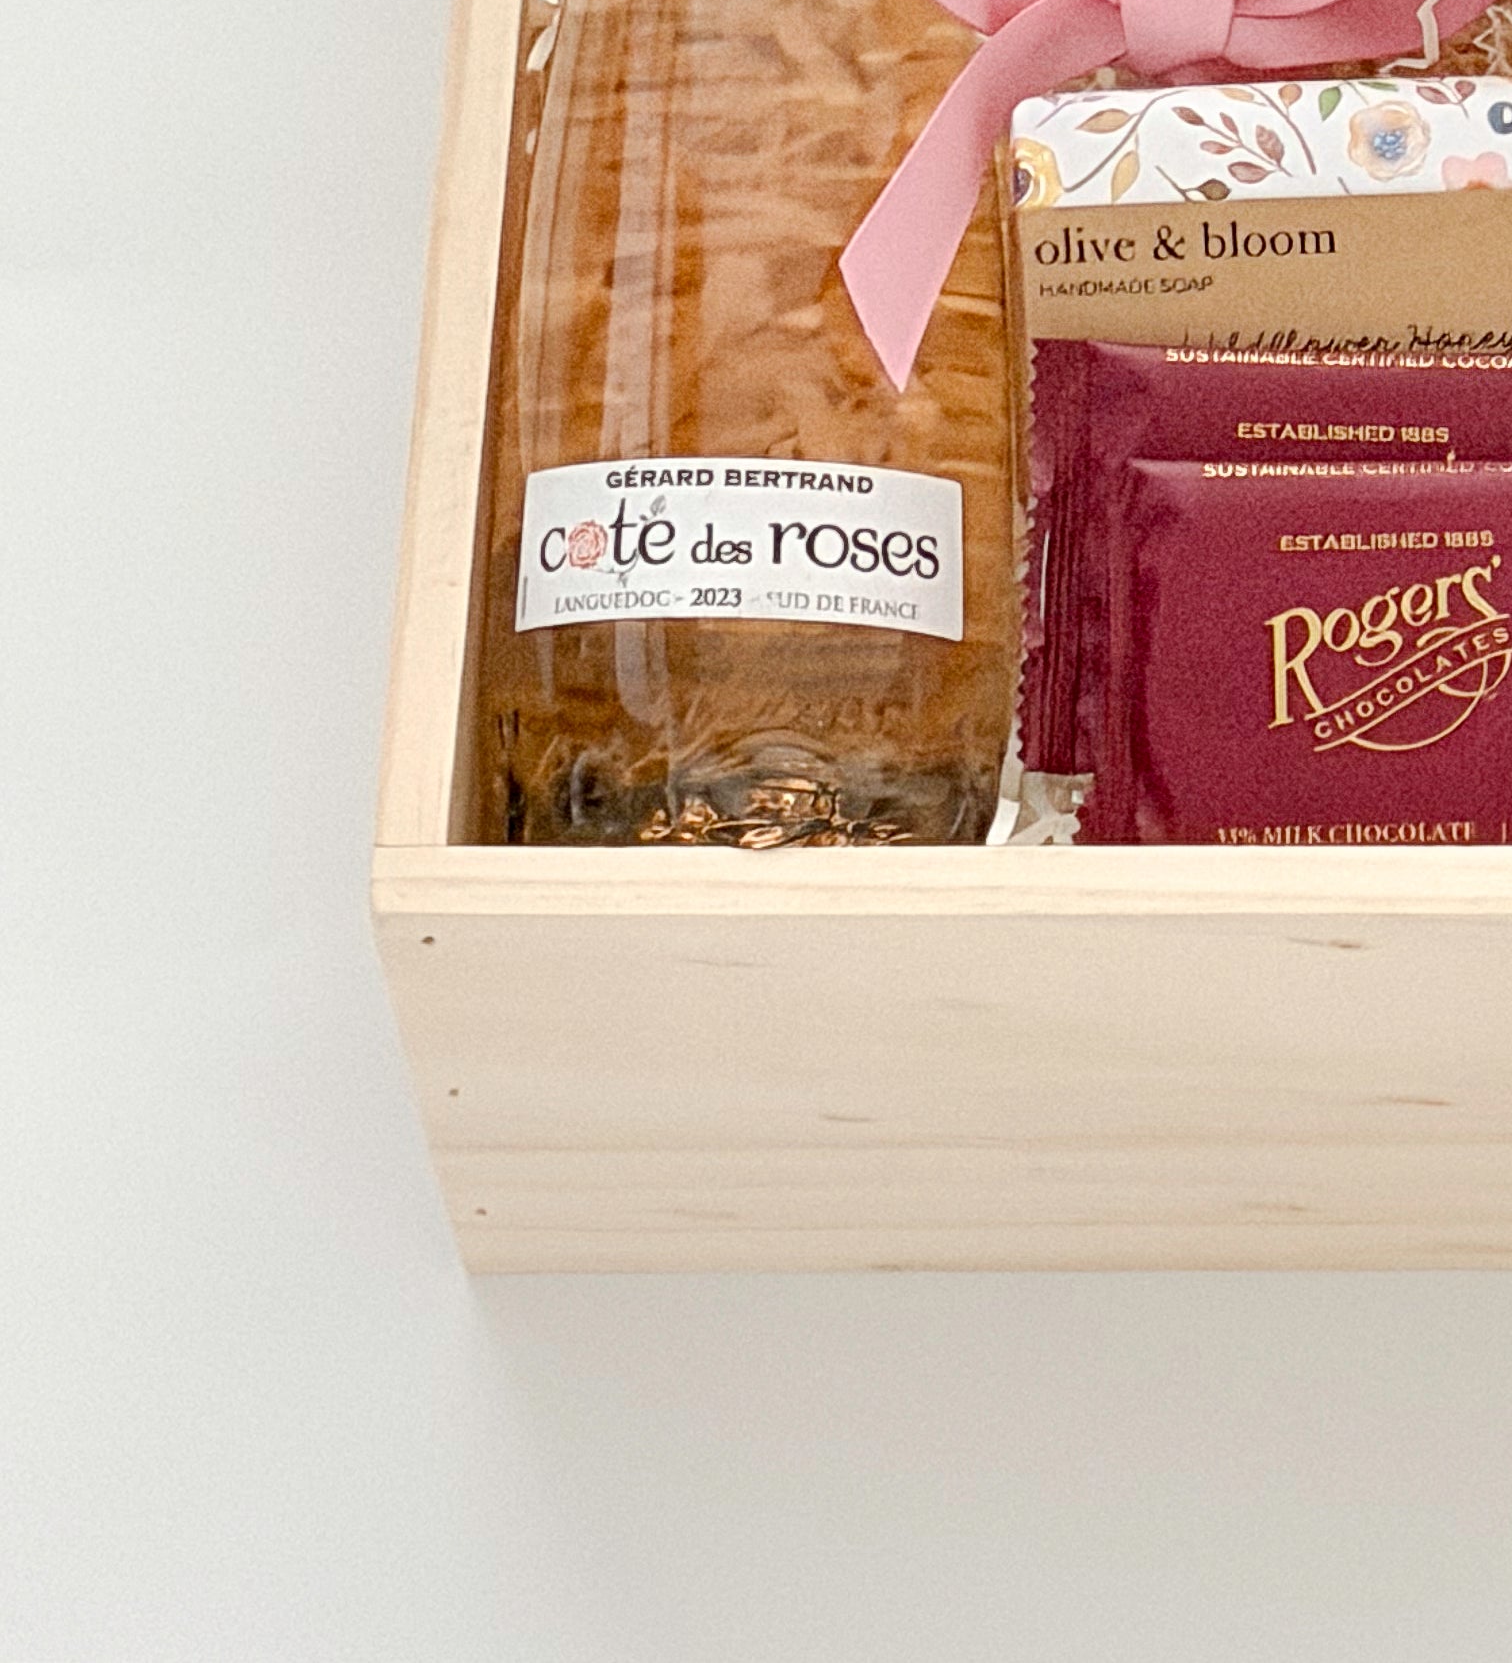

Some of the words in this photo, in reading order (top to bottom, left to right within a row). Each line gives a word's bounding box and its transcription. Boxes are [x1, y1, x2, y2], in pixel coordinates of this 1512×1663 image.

[1034, 226, 1136, 265] olive
[1152, 224, 1186, 261] &
[1202, 220, 1337, 259] bloom
[1039, 279, 1154, 297] HANDMADE
[1159, 275, 1214, 294] SOAP
[1237, 422, 1395, 443] ESTABLISHED
[606, 466, 714, 489] GÉRARD
[724, 469, 874, 494] BERTRAND
[690, 523, 753, 565] des
[768, 521, 940, 580] roses
[1280, 533, 1438, 552] ESTABLISHED
[554, 589, 671, 615] LANGUEDOC
[690, 587, 742, 608] 2023
[816, 594, 845, 612] DE
[849, 596, 921, 621] FRANCE
[1264, 554, 1512, 729] Rogers'
[1314, 627, 1510, 739] CHOCOLATES
